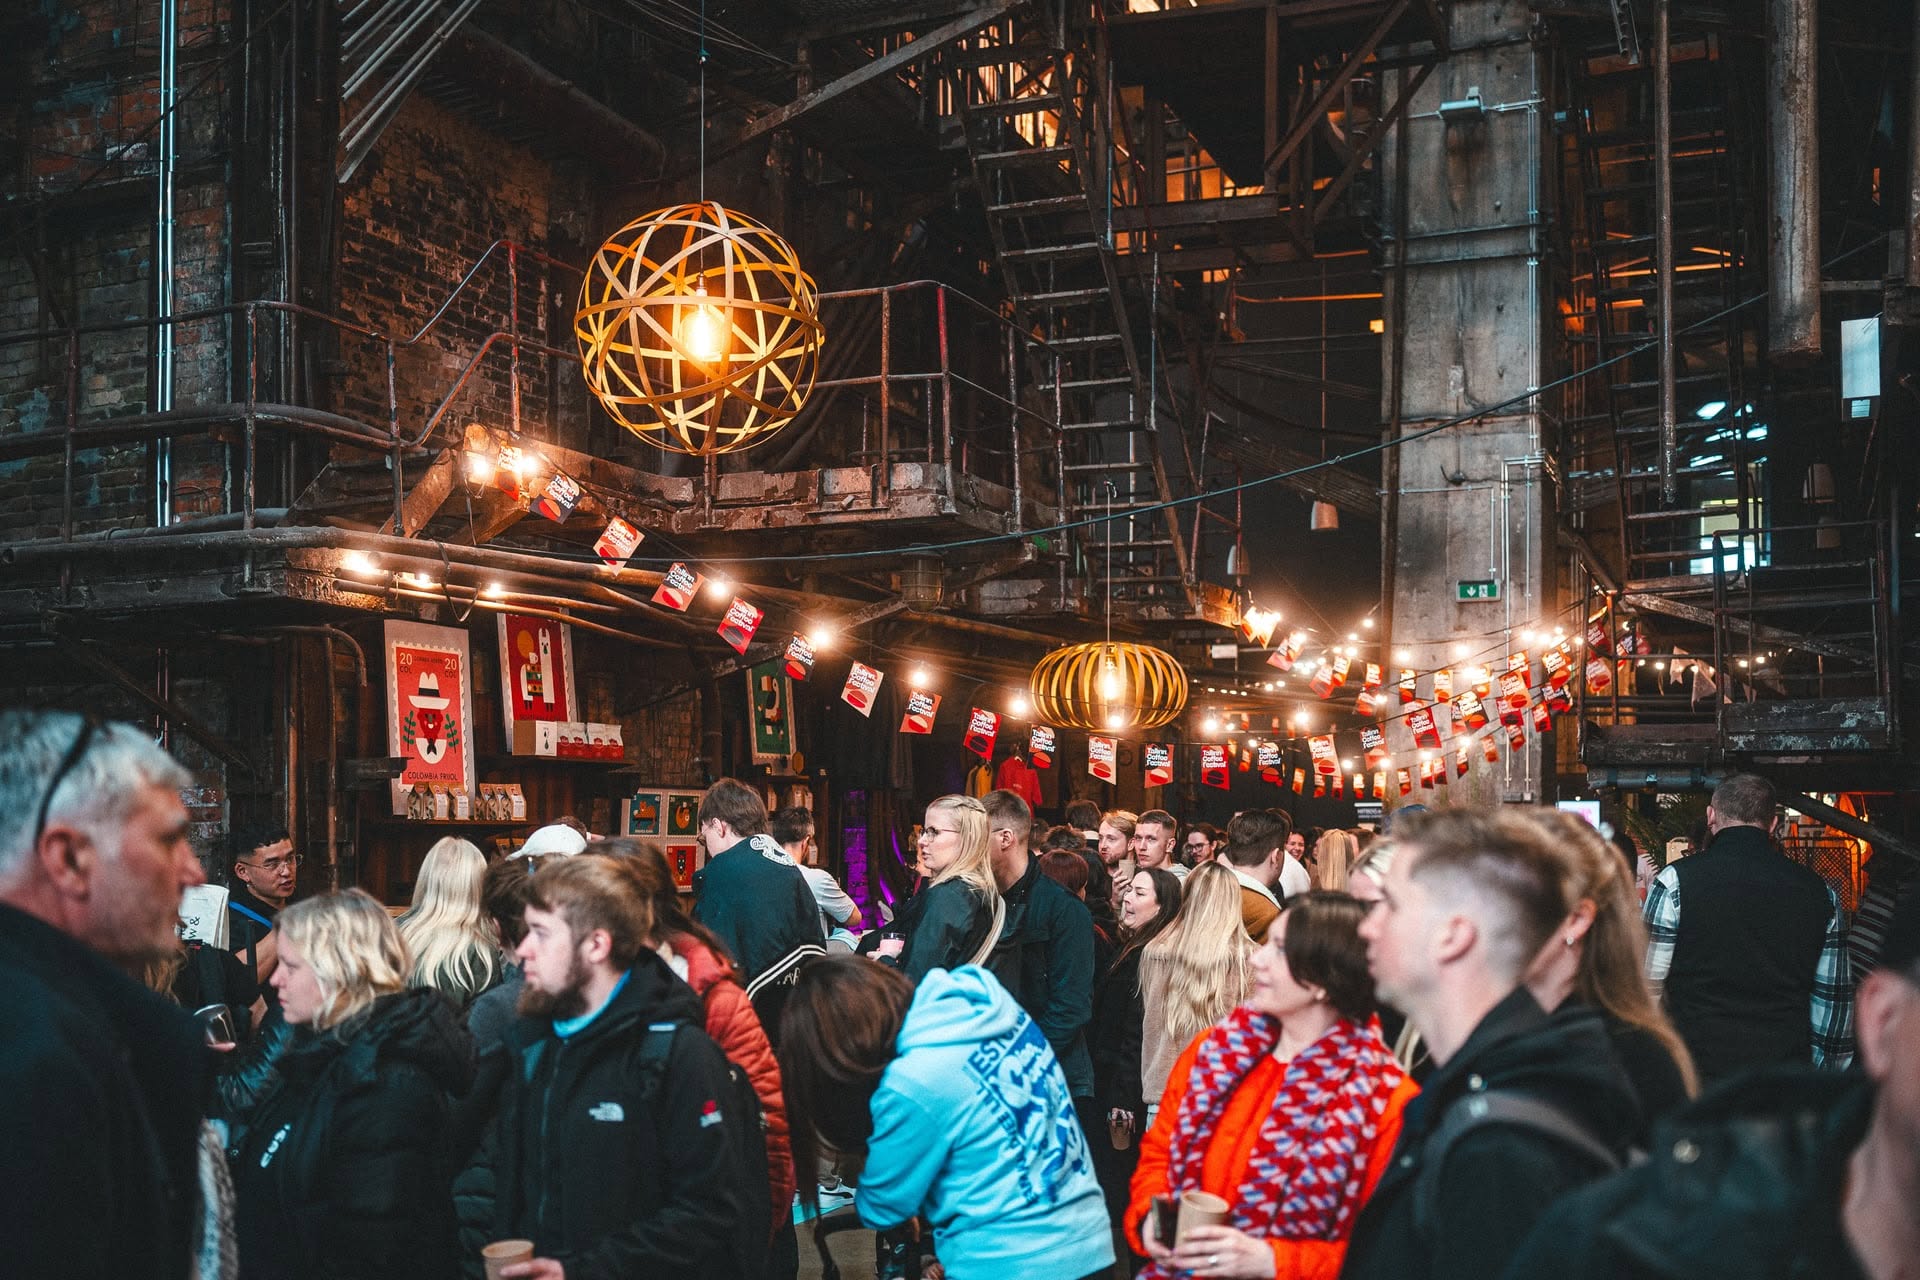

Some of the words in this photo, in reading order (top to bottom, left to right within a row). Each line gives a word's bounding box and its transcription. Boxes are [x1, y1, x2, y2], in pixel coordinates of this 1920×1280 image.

[551, 481, 573, 501] Coffee
[555, 475, 575, 495] Tallinn
[545, 486, 575, 509] Festival
[670, 571, 692, 588] Coffee
[674, 565, 695, 582] Tallinn
[666, 575, 694, 596] Festival
[730, 607, 753, 625] Coffee
[733, 601, 756, 619] Tallinn
[727, 613, 755, 632] Festival
[787, 648, 815, 666] Festival
[790, 643, 812, 659] Coffee
[400, 652, 413, 666] 20
[444, 658, 457, 670] 20
[400, 665, 413, 674] COL
[854, 666, 876, 679] Tallinn
[848, 678, 876, 694] Festival
[851, 672, 874, 687] Coffee
[910, 698, 932, 711] Coffee
[912, 691, 933, 705] Tallinn
[908, 704, 934, 718] Festival
[973, 712, 994, 724] Tallinn
[970, 724, 996, 737] Festival
[972, 719, 993, 731] Coffee
[1031, 735, 1053, 746] Coffee
[1032, 729, 1052, 739] Tallinn
[1362, 735, 1381, 743] Coffee
[1031, 741, 1056, 753] Festival
[1363, 738, 1385, 749] Festival
[1146, 760, 1171, 768] Festival
[1258, 758, 1281, 767] Festival
[408, 771, 438, 780] COLOMBIA
